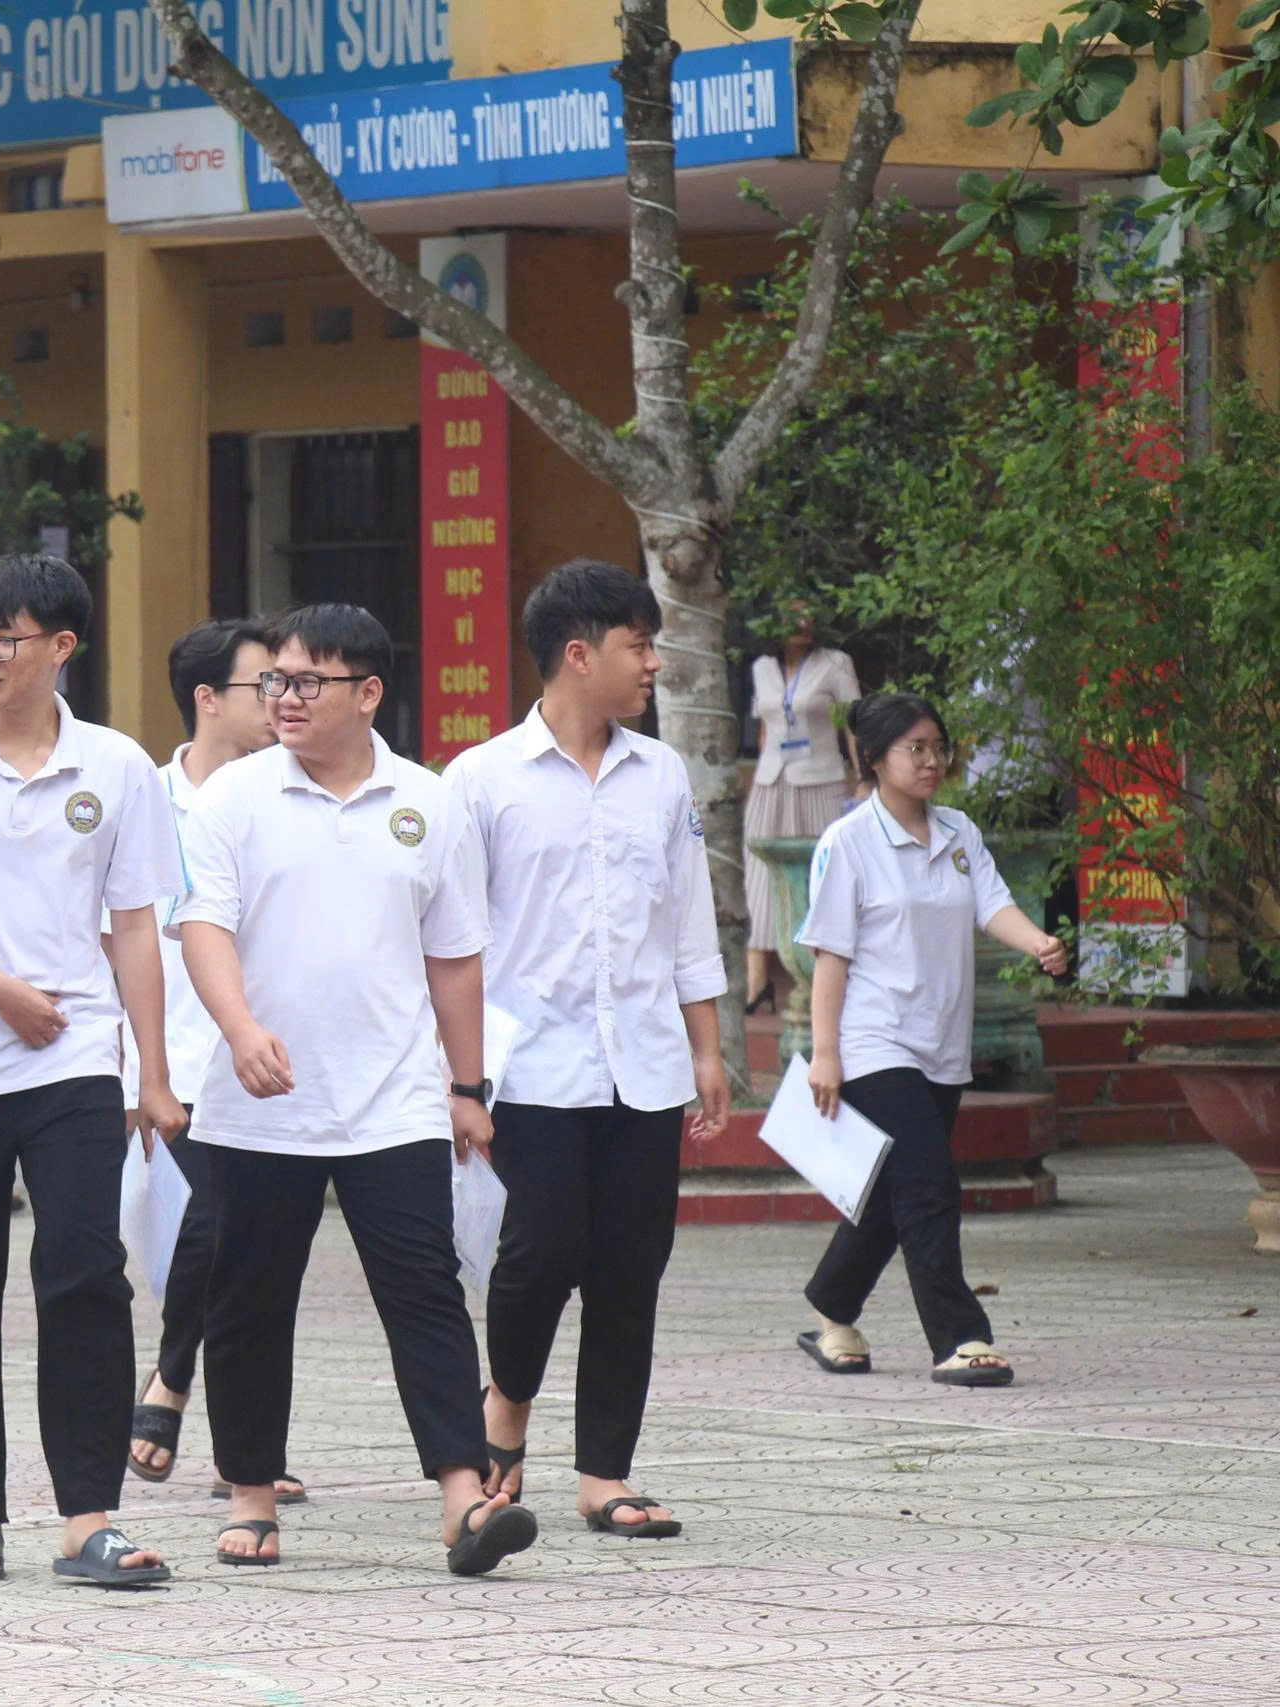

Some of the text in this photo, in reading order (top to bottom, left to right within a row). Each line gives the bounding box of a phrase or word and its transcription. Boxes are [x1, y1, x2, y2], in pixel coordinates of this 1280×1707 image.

[238, 0, 323, 80] NON
[357, 98, 384, 174] KỶ
[473, 92, 523, 162] TÌNH
[702, 59, 776, 144] NHIỆM
[120, 142, 225, 177] mobifone
[444, 420, 482, 448] BAO
[445, 567, 483, 601] HỌC
[454, 611, 475, 644] VÌ
